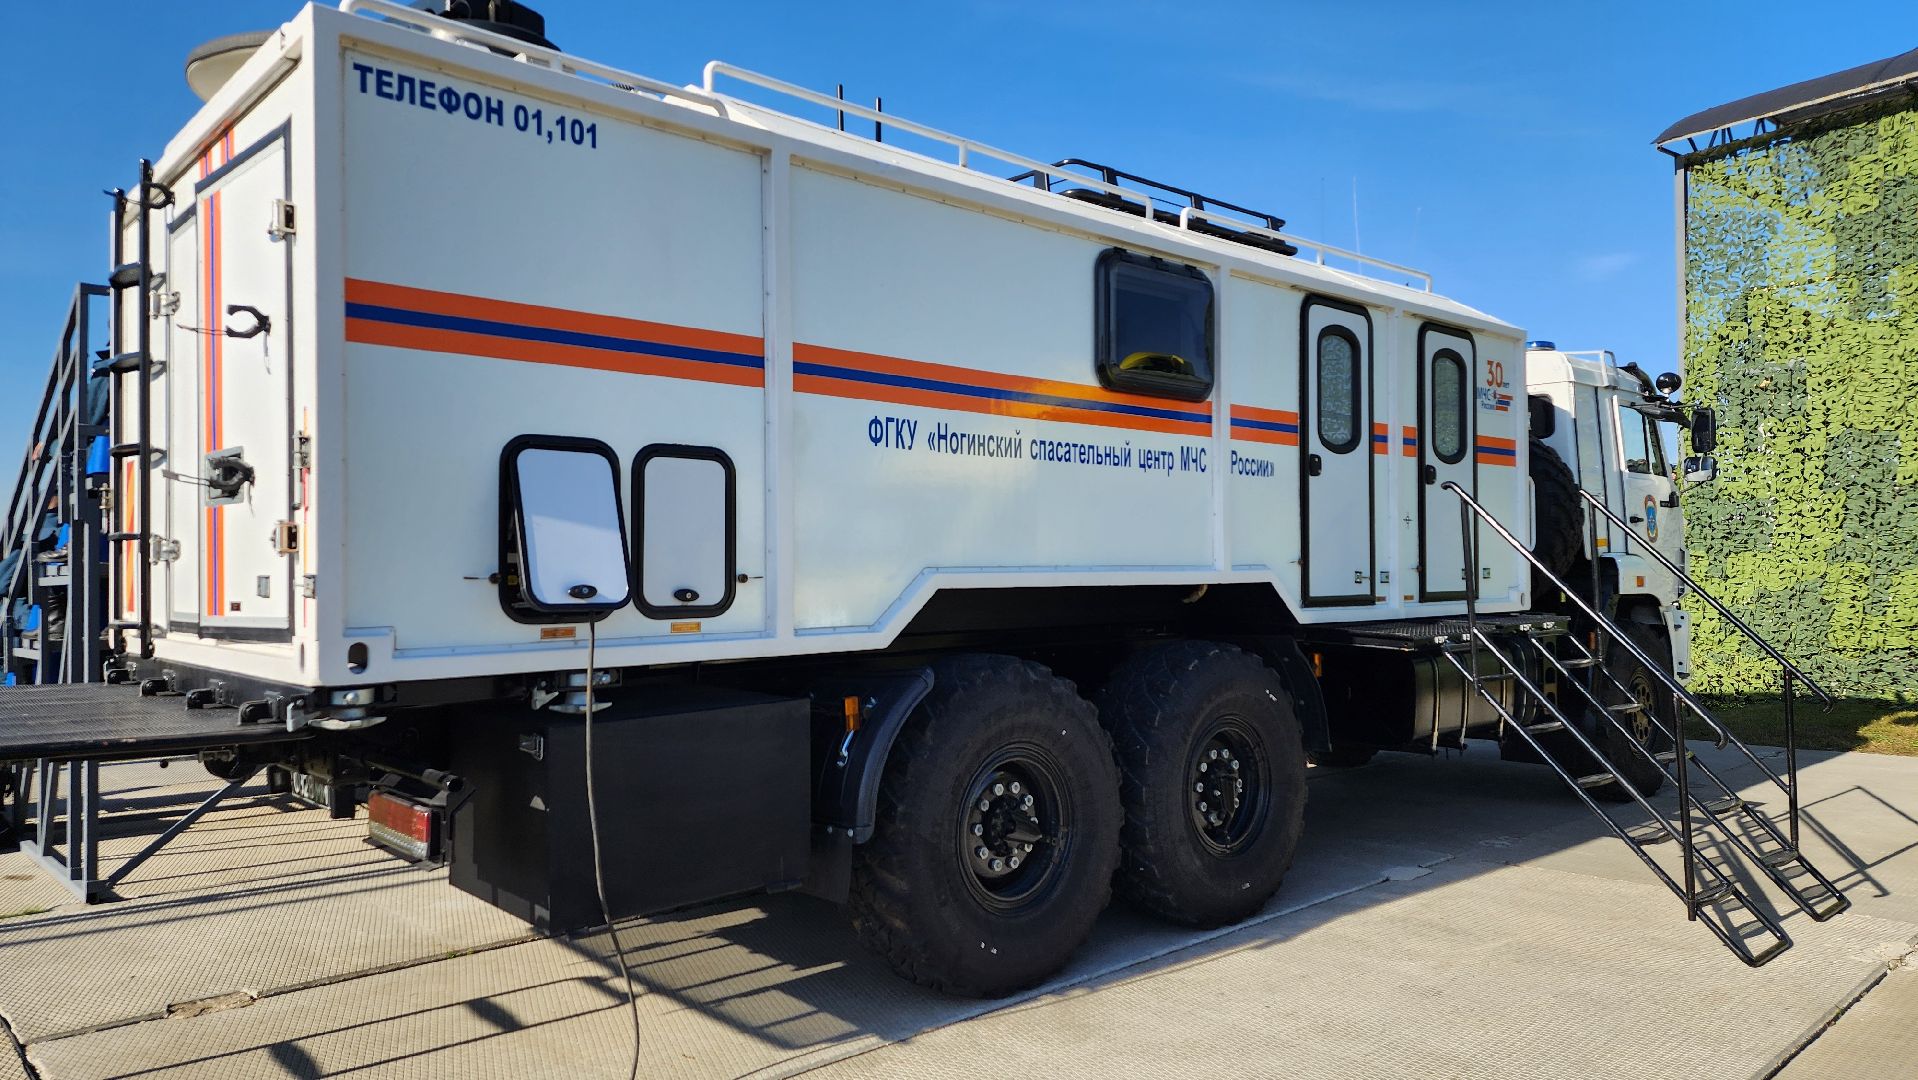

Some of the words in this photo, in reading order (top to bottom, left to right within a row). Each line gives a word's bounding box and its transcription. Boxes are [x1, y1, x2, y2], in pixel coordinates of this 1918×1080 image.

[353, 62, 504, 127] ТЕЛЕФОН
[513, 104, 597, 149] 01,101
[1487, 360, 1503, 387] 30
[868, 415, 918, 450] ФГКУ
[927, 422, 1022, 459] «Ногинский
[1030, 439, 1131, 468] спасательный
[1138, 448, 1175, 477] центр
[1180, 445, 1207, 473] МЧС
[1230, 450, 1275, 478] России»
